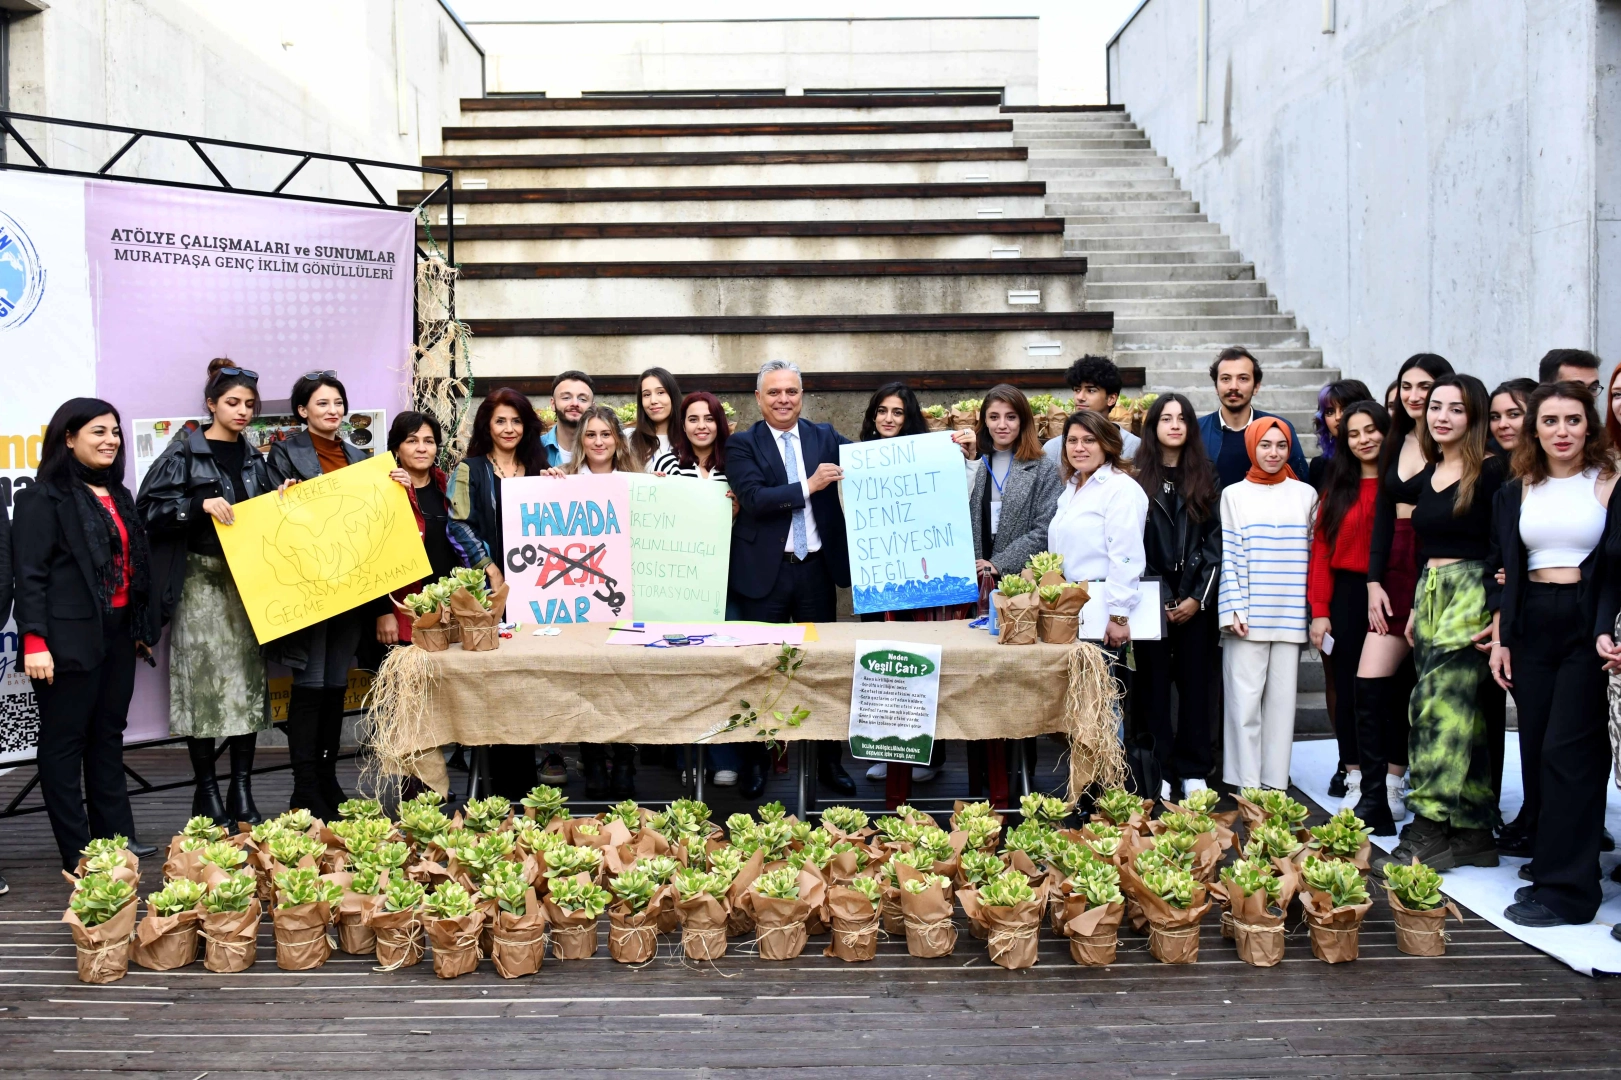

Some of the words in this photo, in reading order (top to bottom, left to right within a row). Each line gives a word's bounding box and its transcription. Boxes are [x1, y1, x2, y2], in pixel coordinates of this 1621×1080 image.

[110, 227, 176, 246] ATÖLYE
[180, 234, 290, 255] ÇALIŞMALARI
[293, 246, 310, 256] ve
[314, 245, 396, 264] SUNUMLAR
[114, 248, 212, 269] MURATPAŞA
[214, 256, 255, 273] GENÇ
[257, 256, 299, 274] İKLİM
[302, 262, 394, 280] GÖNÜLLÜLERİ
[851, 440, 916, 470] SESİNİ
[851, 470, 941, 502] YÜKSELT
[520, 499, 621, 537] HAVADA
[630, 509, 676, 529] İREYİN
[853, 501, 916, 531] DENİZ
[856, 522, 955, 561] SEVİYESİNİ
[858, 559, 916, 587] DEĞİL
[528, 596, 591, 625] VAR
[867, 659, 893, 675] Yeşil
[895, 662, 918, 675] Çatı
[888, 653, 909, 662] Neden
